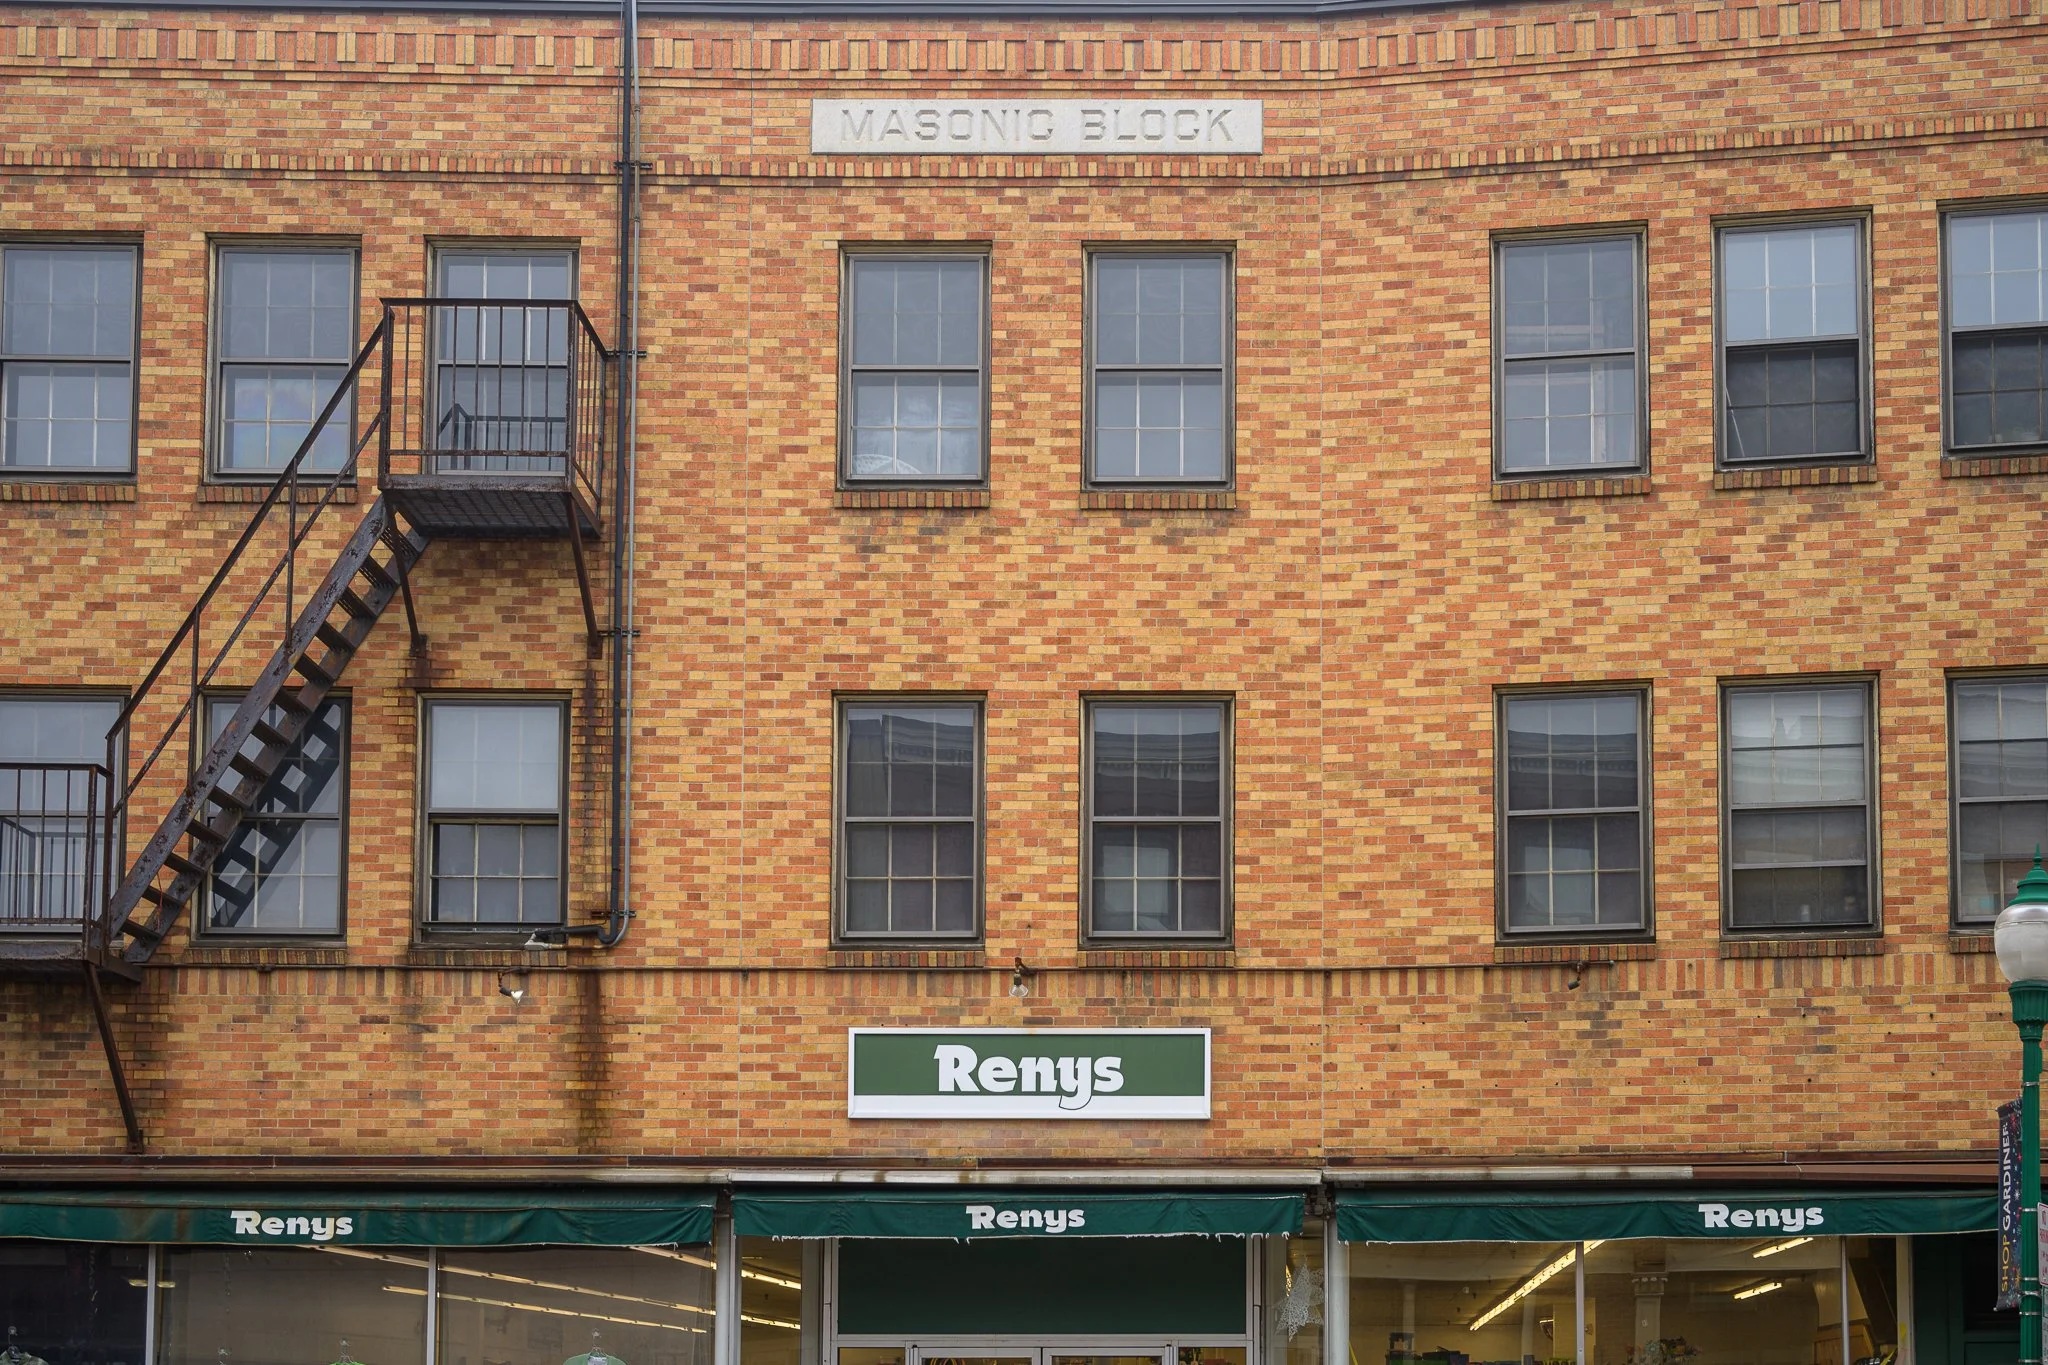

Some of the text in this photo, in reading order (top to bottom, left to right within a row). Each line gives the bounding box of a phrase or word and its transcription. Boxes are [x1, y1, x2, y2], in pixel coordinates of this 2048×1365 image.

[839, 109, 1235, 142] MASONIC BLOCK
[933, 1044, 1125, 1111] Renys
[965, 1205, 1086, 1234] Renys
[1698, 1203, 1825, 1233] Renys
[2001, 1121, 2012, 1293] SHOP GARDINER
[230, 1210, 354, 1241] Renys
